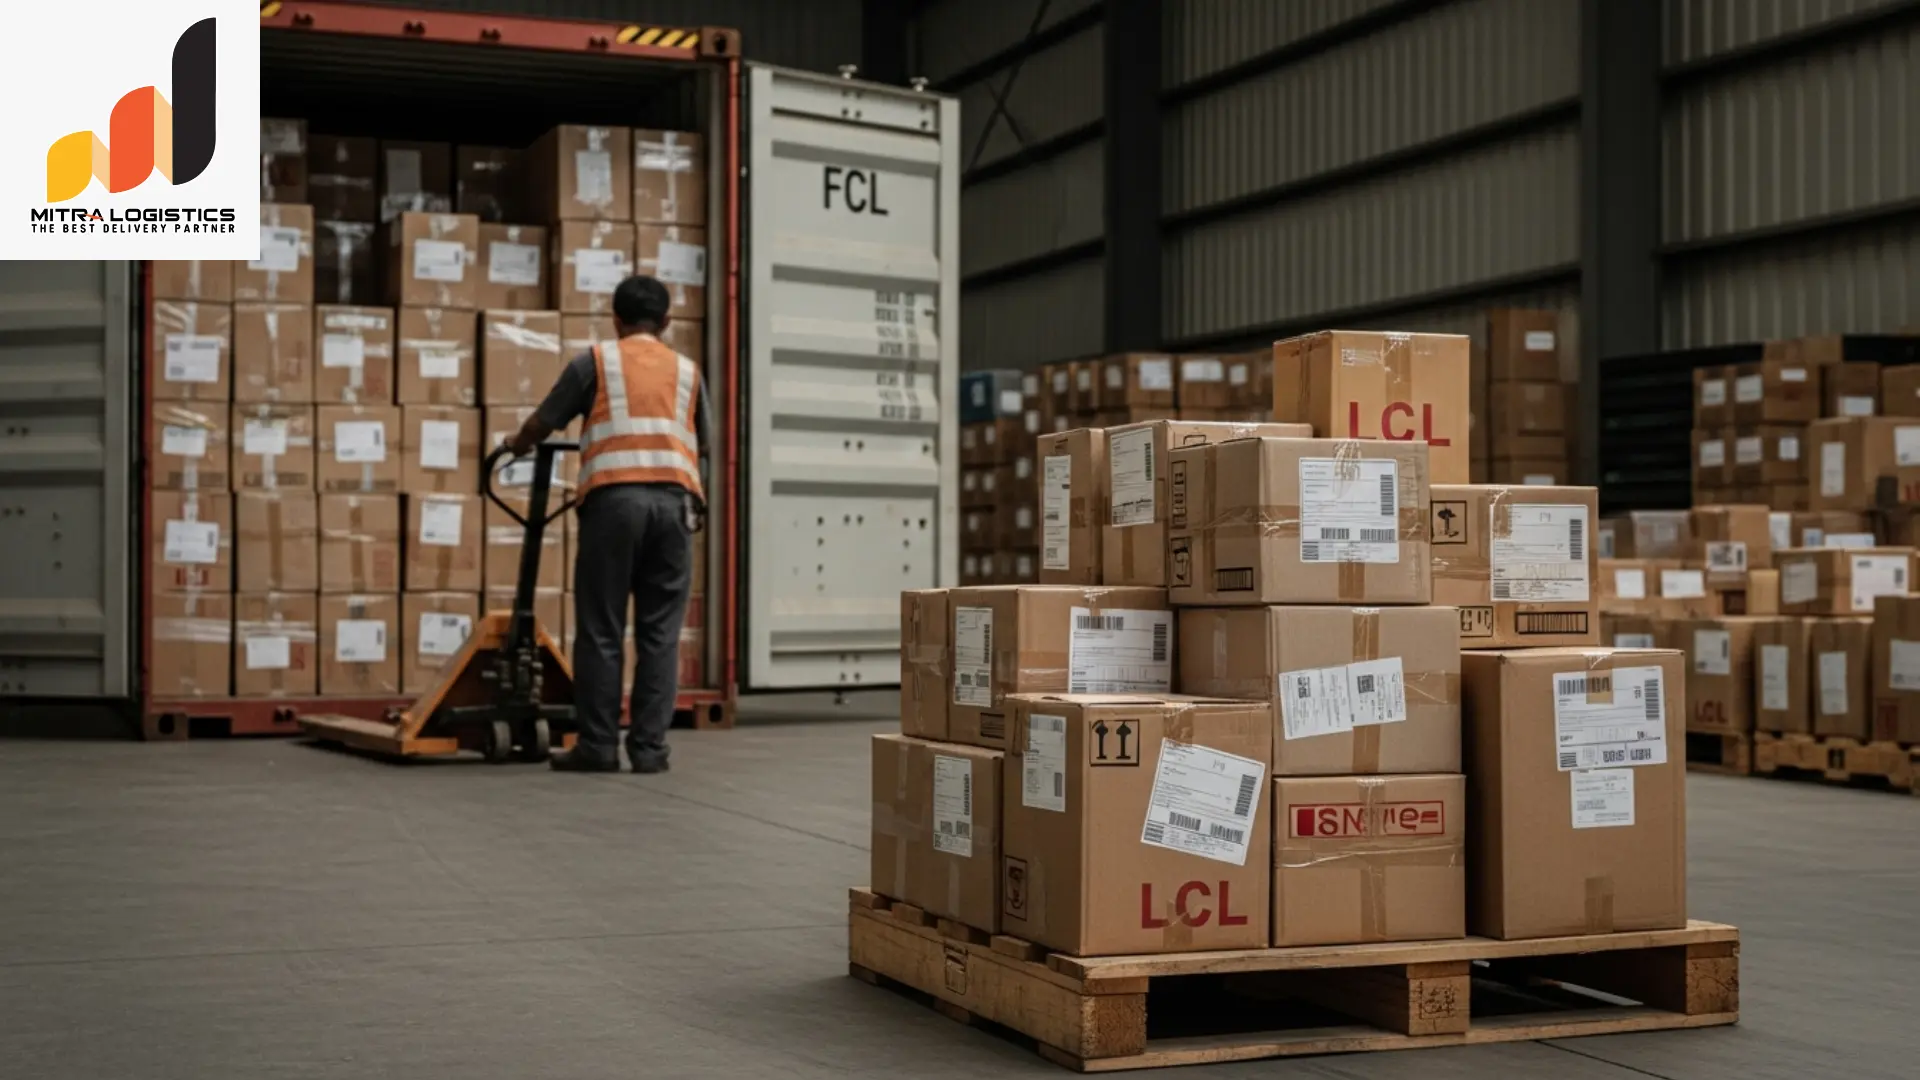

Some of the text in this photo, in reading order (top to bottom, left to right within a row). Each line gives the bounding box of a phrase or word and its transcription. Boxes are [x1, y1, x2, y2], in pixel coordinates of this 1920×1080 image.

[824, 165, 889, 217] FCL
[1348, 401, 1451, 447] LCL
[1140, 880, 1248, 929] LCL
